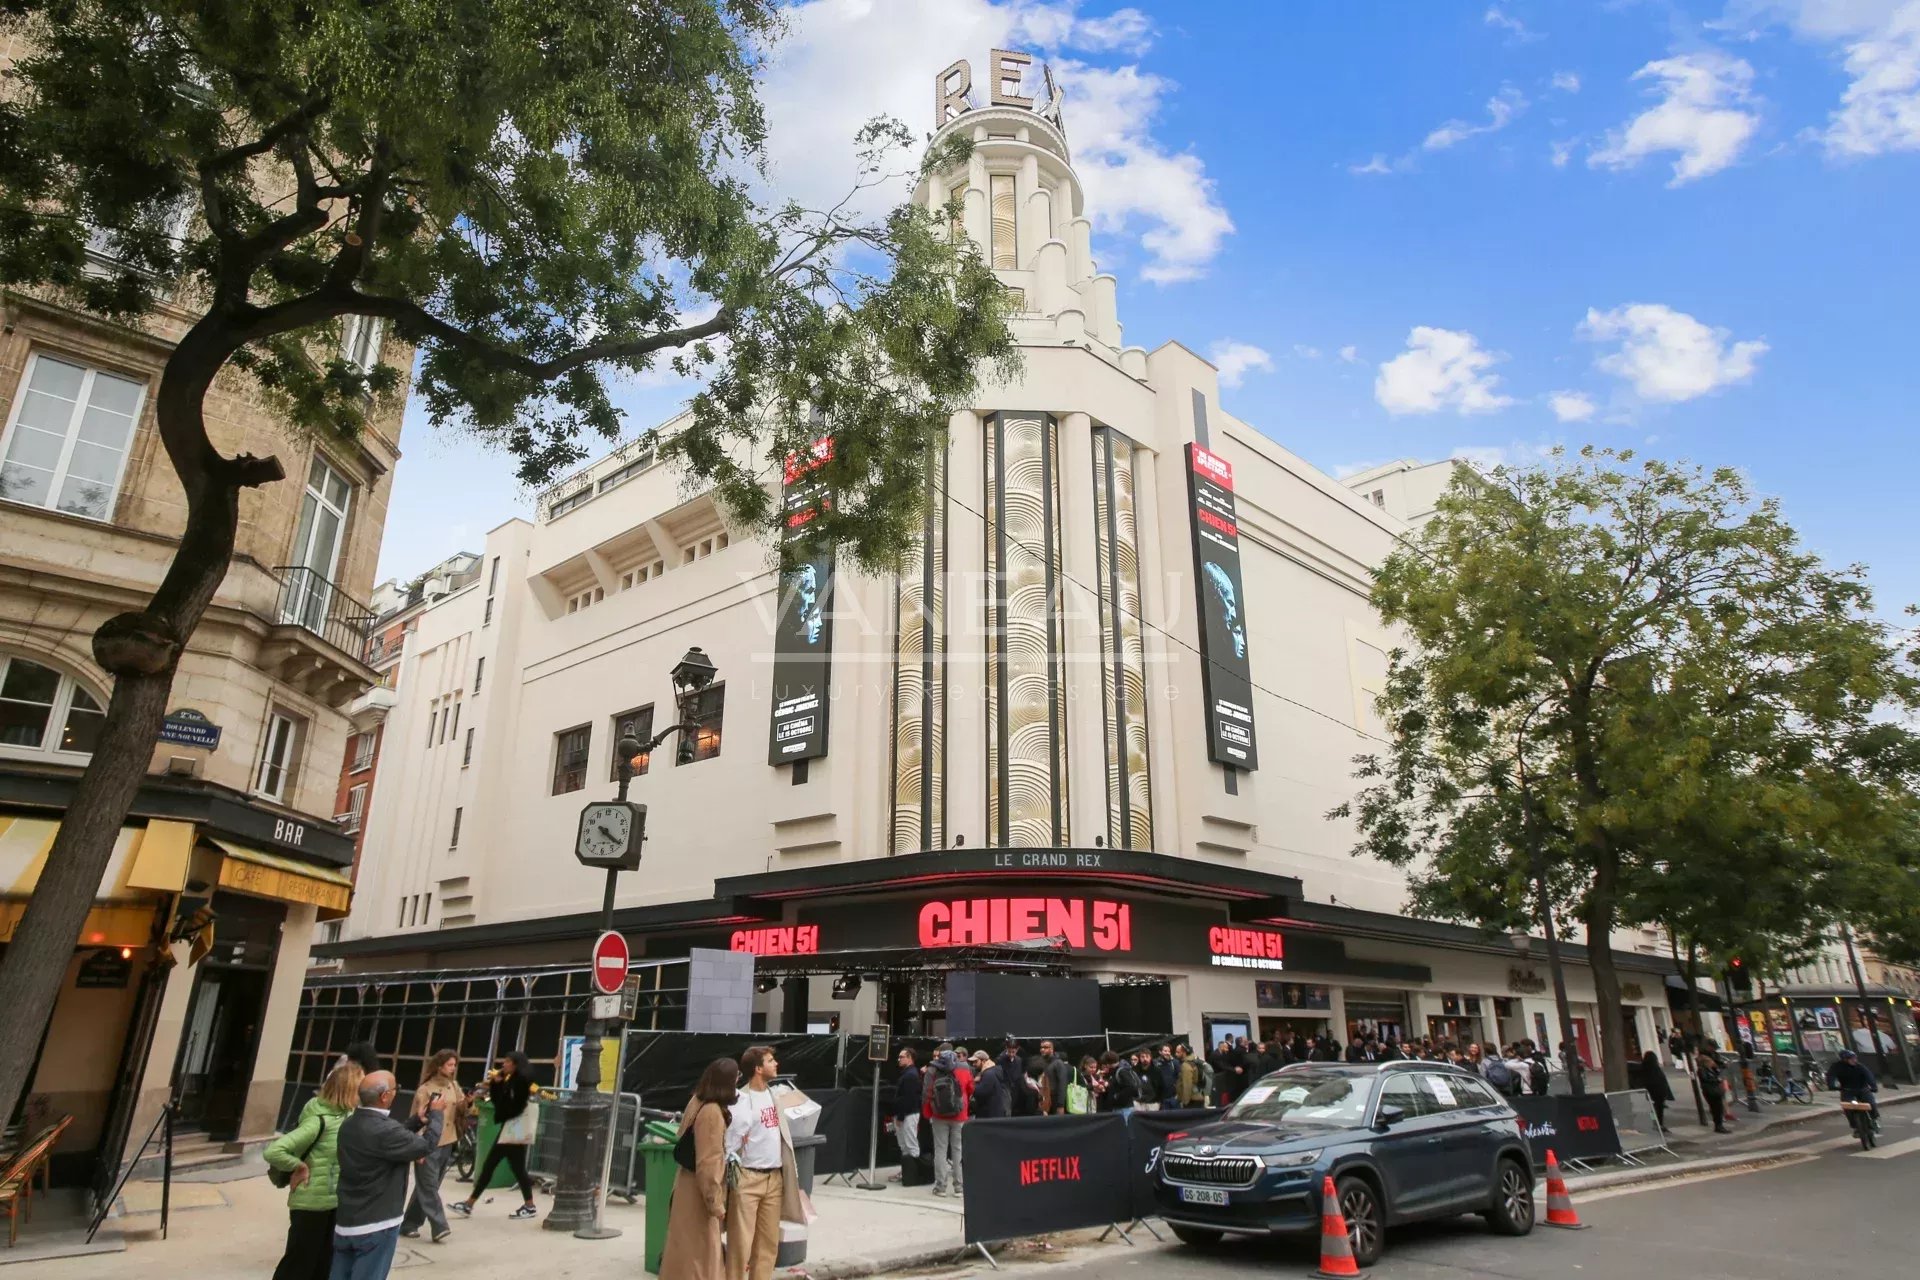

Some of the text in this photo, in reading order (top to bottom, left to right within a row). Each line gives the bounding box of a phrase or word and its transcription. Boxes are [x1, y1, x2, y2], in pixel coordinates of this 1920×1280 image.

[936, 48, 1066, 140] REX
[165, 723, 207, 734] BOULEVARD
[274, 819, 304, 845] BAR
[995, 854, 1101, 867] LE GRAND REX
[731, 925, 818, 955] CHIEN 51
[918, 899, 1131, 951] CHIEN 51
[1209, 927, 1283, 958] CHIEN 51
[1020, 1156, 1081, 1186] NETFLIX
